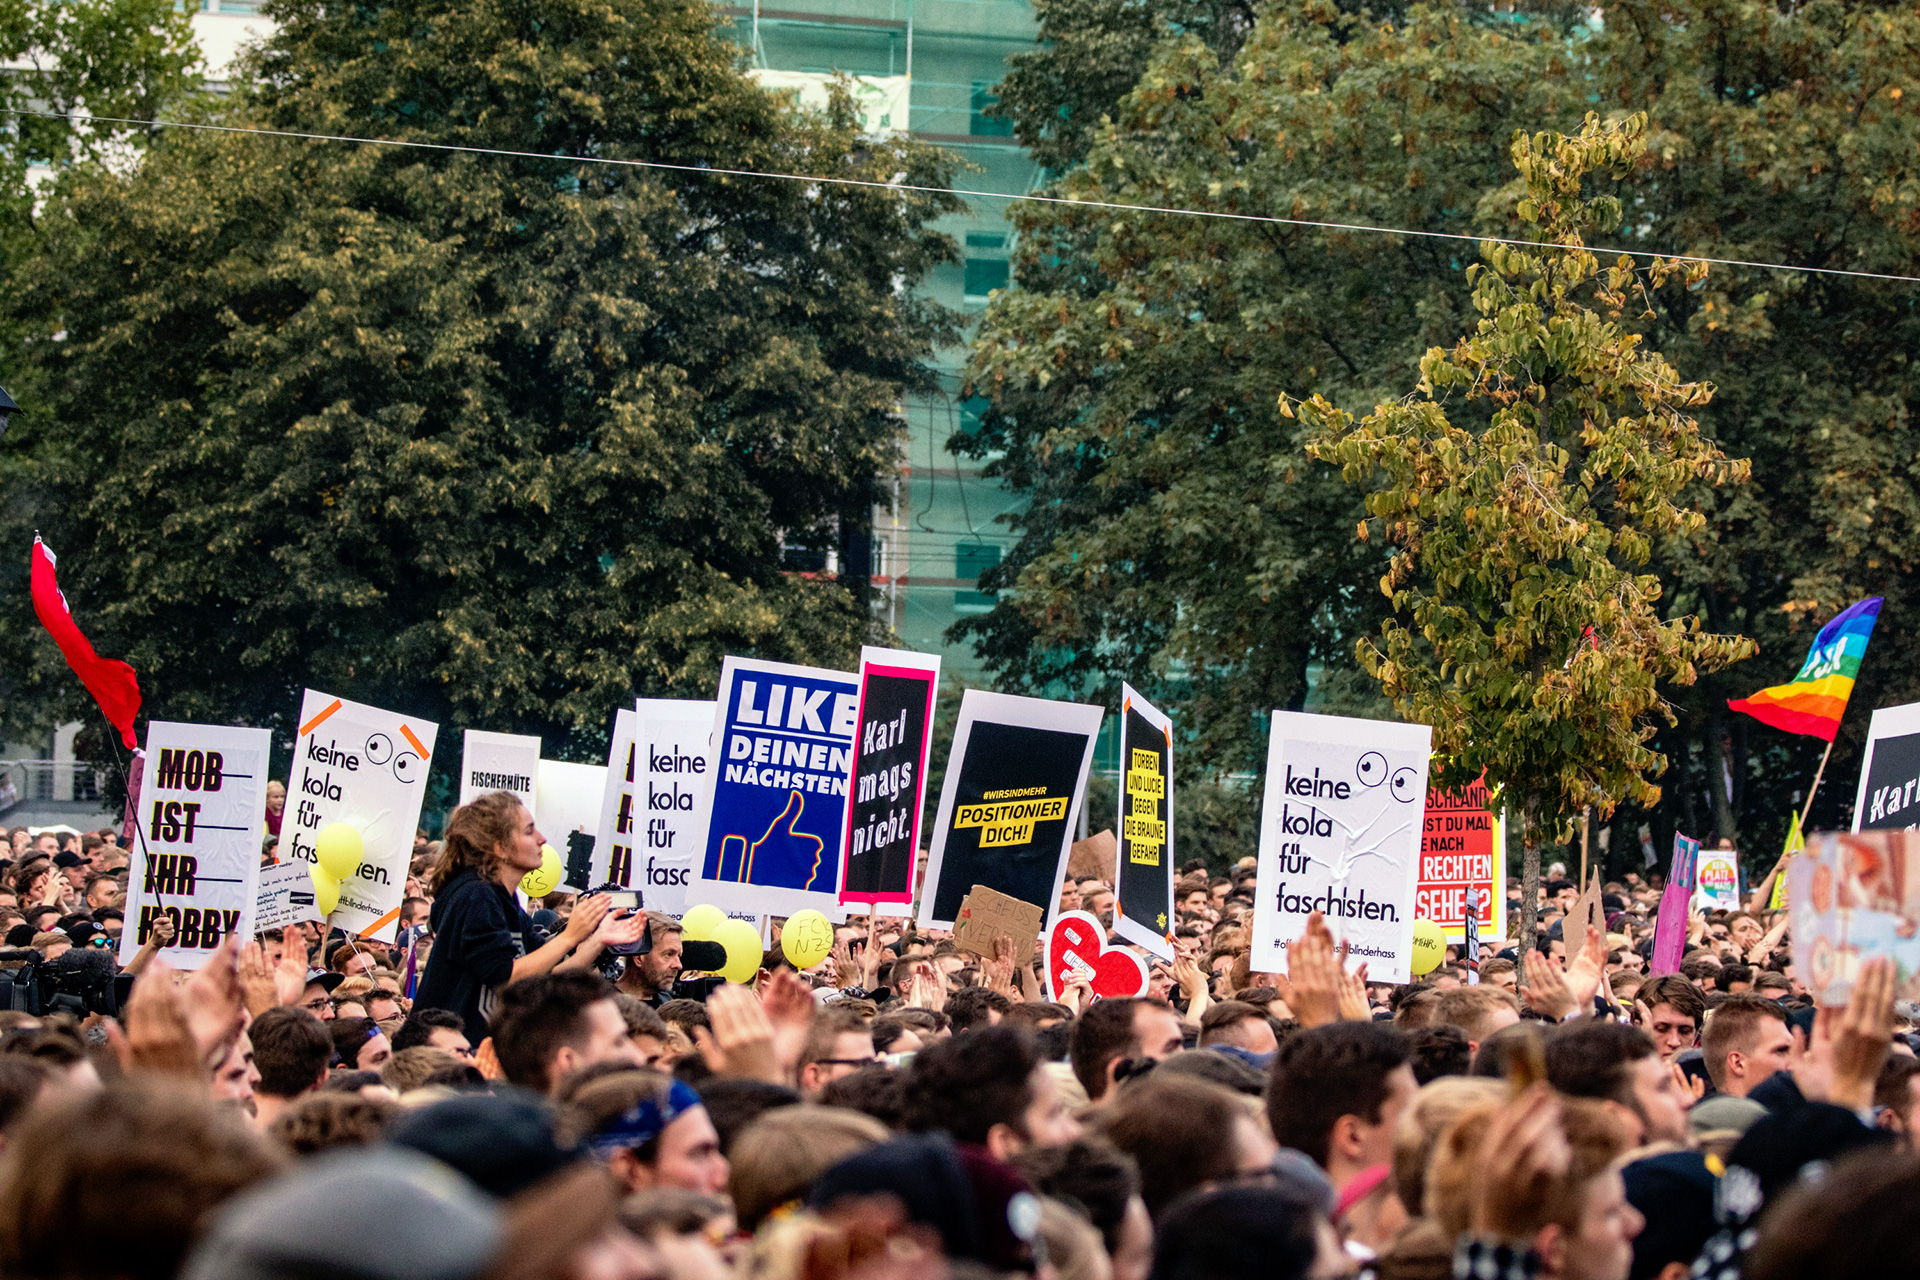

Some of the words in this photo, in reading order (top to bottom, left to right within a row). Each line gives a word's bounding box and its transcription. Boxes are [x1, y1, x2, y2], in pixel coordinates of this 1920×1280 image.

[736, 680, 858, 737] LIKE
[863, 708, 907, 756] Karl
[308, 734, 359, 771] keine
[650, 743, 706, 774] keine
[729, 734, 851, 774] DEINEN
[1134, 752, 1157, 771] TORBEN
[157, 748, 223, 792] MOB
[302, 766, 342, 802] kola
[471, 771, 530, 792] FISCHERHÜTE
[725, 761, 848, 797] NÄCHSTEN
[858, 761, 912, 803] mags
[1130, 774, 1142, 791] UND
[1144, 776, 1161, 794] LUCIE
[1285, 764, 1351, 799] keine
[648, 781, 693, 811] kola
[983, 786, 1047, 800] #WIRSINDMEHR
[1134, 798, 1155, 815] GEGEN
[1426, 787, 1487, 809] SCHLAND
[150, 800, 201, 843] IST
[297, 800, 322, 829] für
[960, 801, 1062, 824] POSITIONIER
[1282, 804, 1332, 837] kola
[1446, 816, 1463, 832] DU
[1466, 816, 1491, 831] MAL
[647, 819, 676, 848] für
[852, 807, 910, 856] nicht.
[985, 824, 1028, 843] DICH!
[1126, 819, 1136, 836] DIE
[1137, 821, 1163, 839] BRAUNE
[1430, 836, 1464, 852] NACH
[1132, 843, 1157, 861] GEFAHR
[1279, 842, 1311, 874] für
[143, 852, 198, 896] IHR
[1423, 854, 1492, 881] RECHTEN
[1276, 882, 1400, 923] faschisten.
[1416, 888, 1491, 921] SEHE?
[137, 905, 241, 949] HOBBY
[799, 918, 832, 936] FCK
[795, 934, 832, 955] NZS
